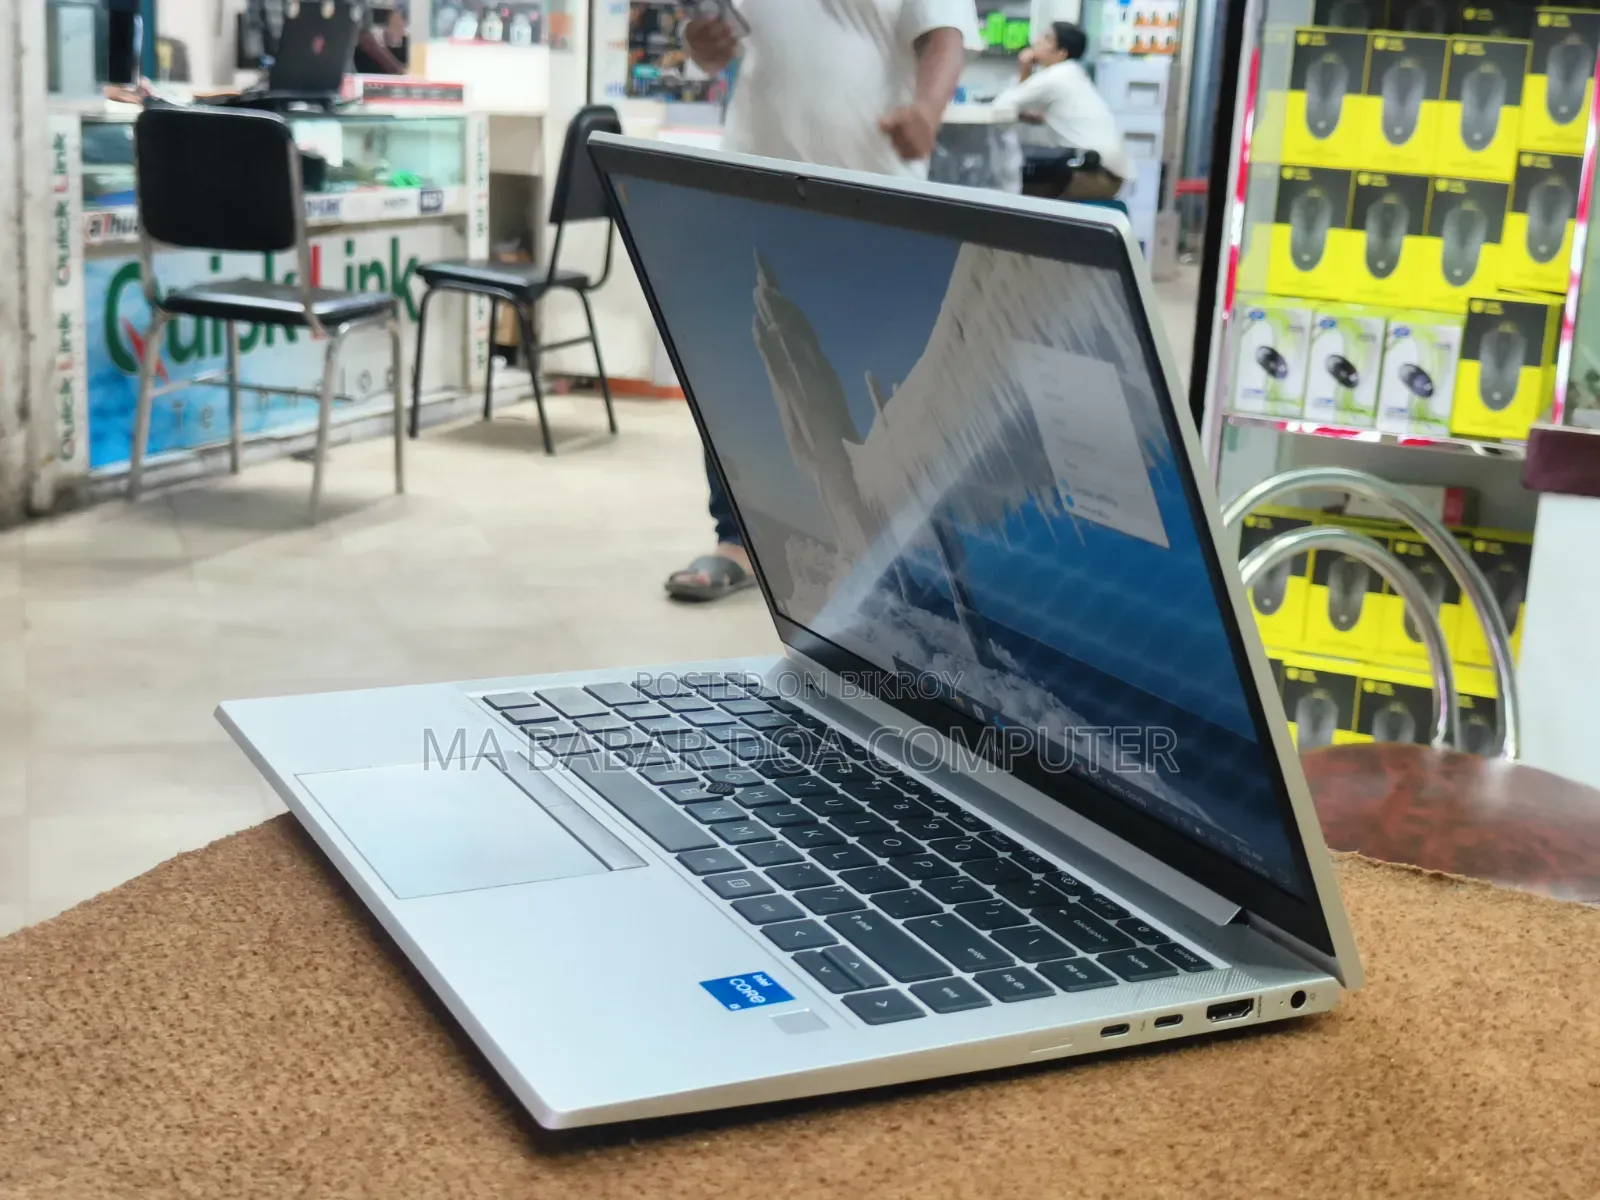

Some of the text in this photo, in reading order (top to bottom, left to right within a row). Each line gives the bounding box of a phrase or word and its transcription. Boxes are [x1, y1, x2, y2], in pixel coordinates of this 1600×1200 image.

[733, 826, 753, 836] M
[803, 829, 823, 838] K
[833, 851, 849, 859] L
[913, 860, 934, 868] P
